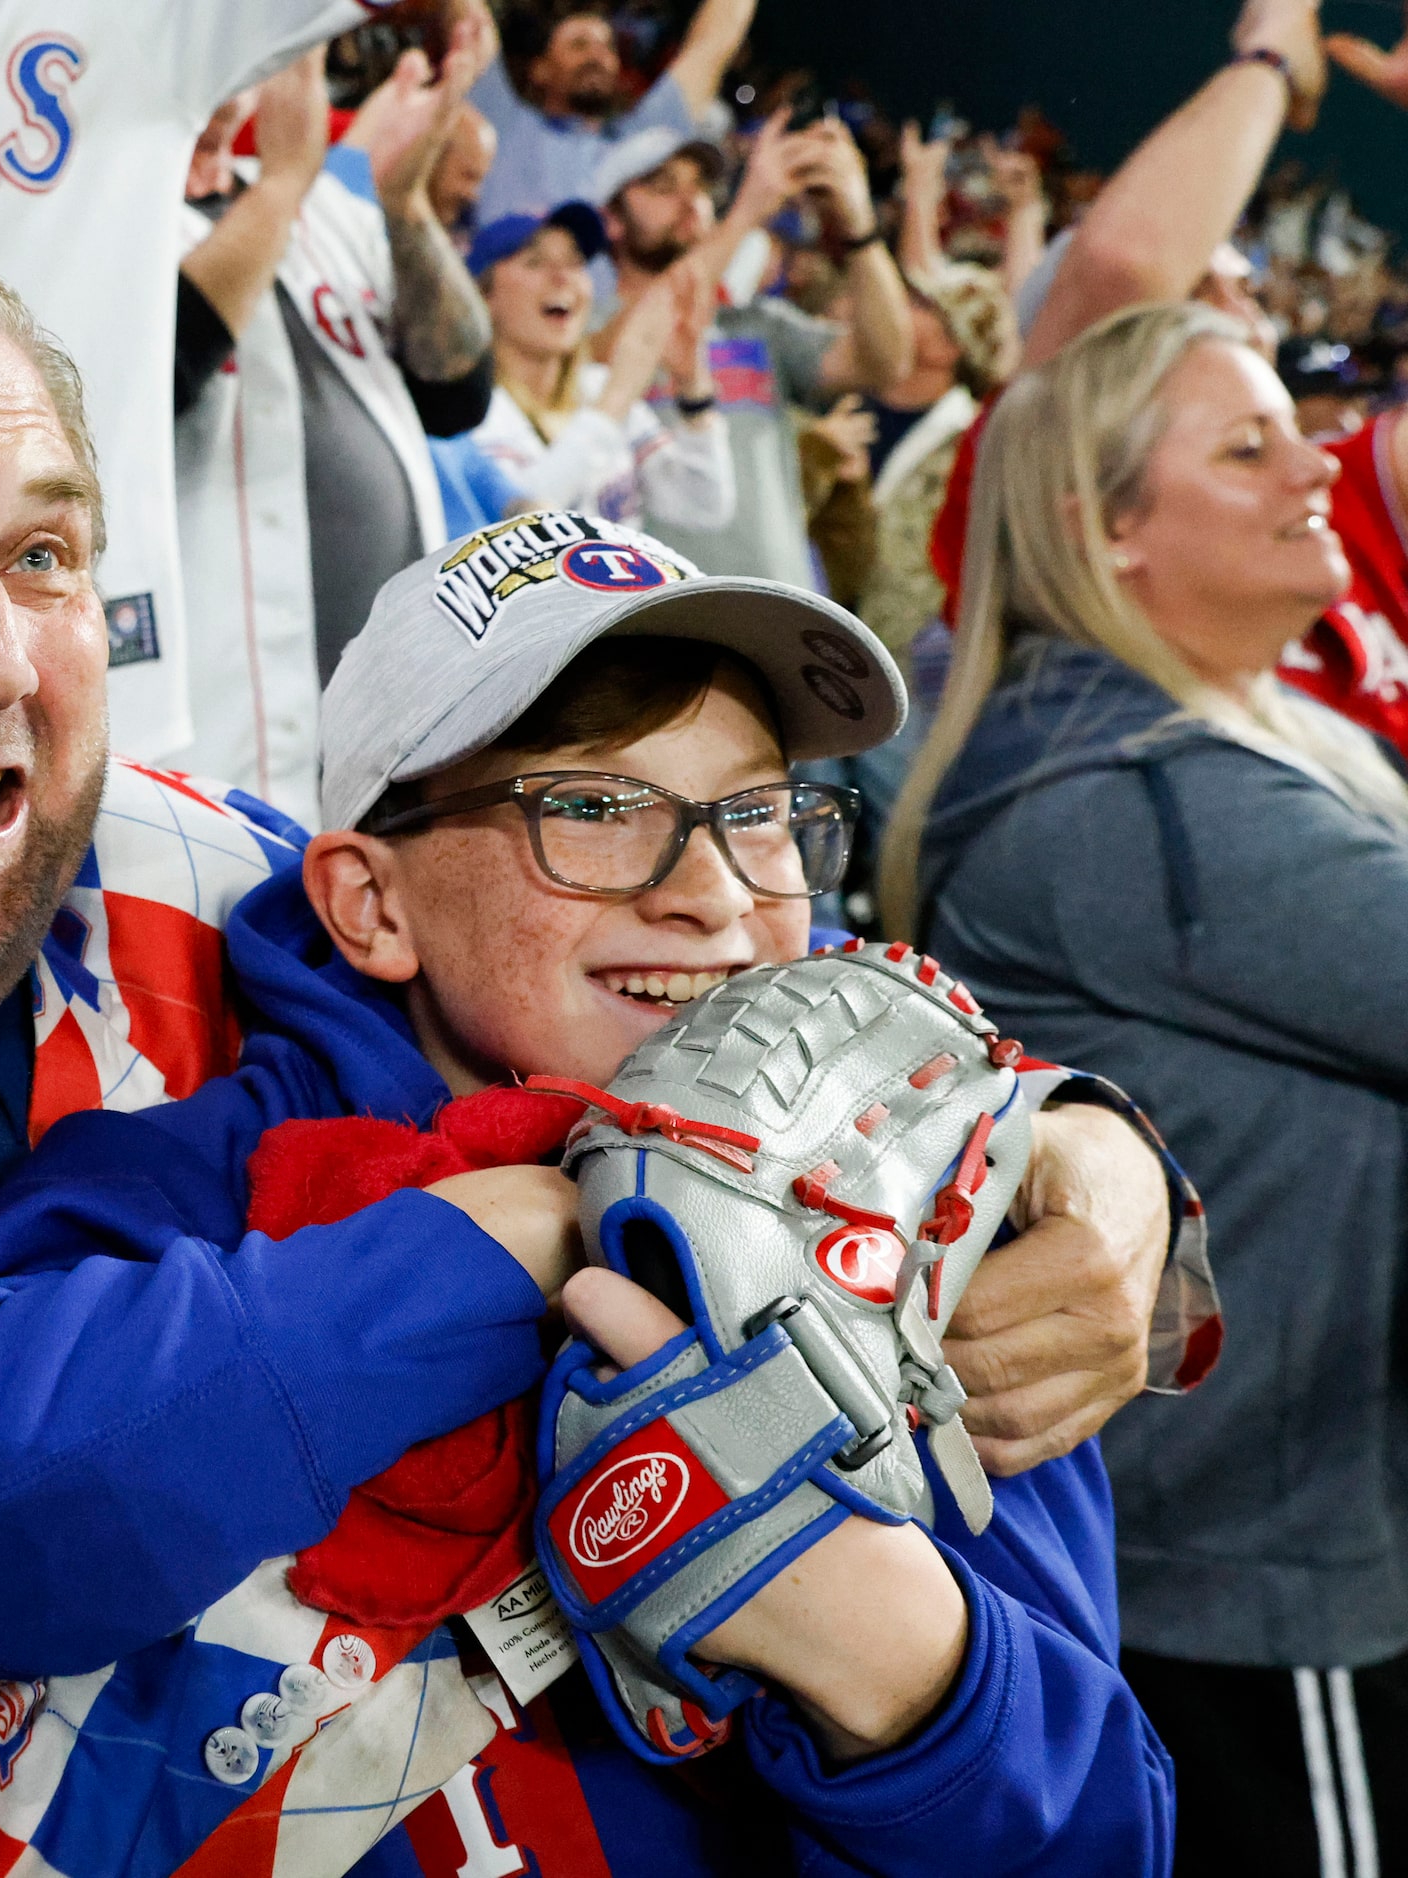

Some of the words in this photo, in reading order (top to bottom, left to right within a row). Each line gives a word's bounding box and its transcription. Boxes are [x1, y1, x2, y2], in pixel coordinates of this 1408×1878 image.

[438, 512, 586, 640] WORLD
[581, 1458, 667, 1561] Rawlings
[498, 1597, 523, 1618] AA
[522, 1580, 548, 1602] MIL
[498, 1634, 523, 1654] 100%
[524, 1638, 551, 1658] Made
[529, 1649, 558, 1672] Hecho
